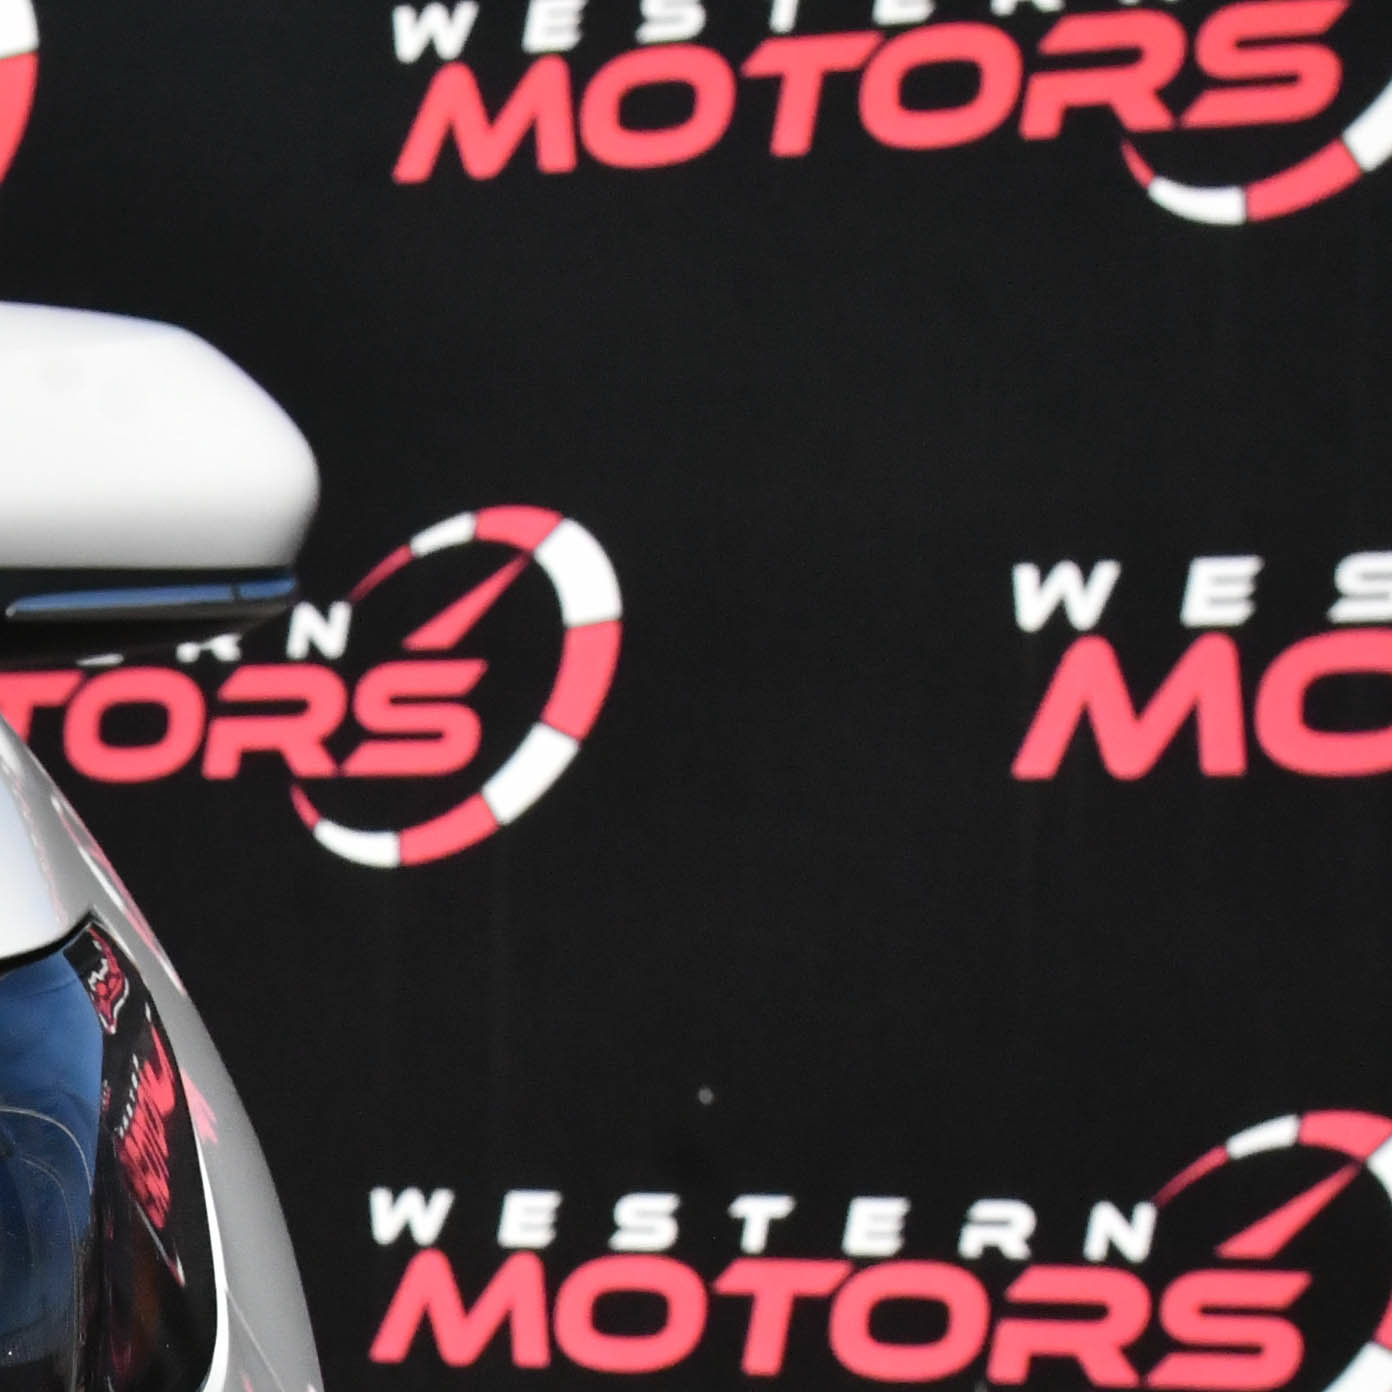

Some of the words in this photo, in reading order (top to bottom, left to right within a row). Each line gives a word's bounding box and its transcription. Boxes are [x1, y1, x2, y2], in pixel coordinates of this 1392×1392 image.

[391, 0, 1351, 186] MOTORS
[369, 1186, 1158, 1263] WESTERN
[369, 1246, 1314, 1392] MOTORS
